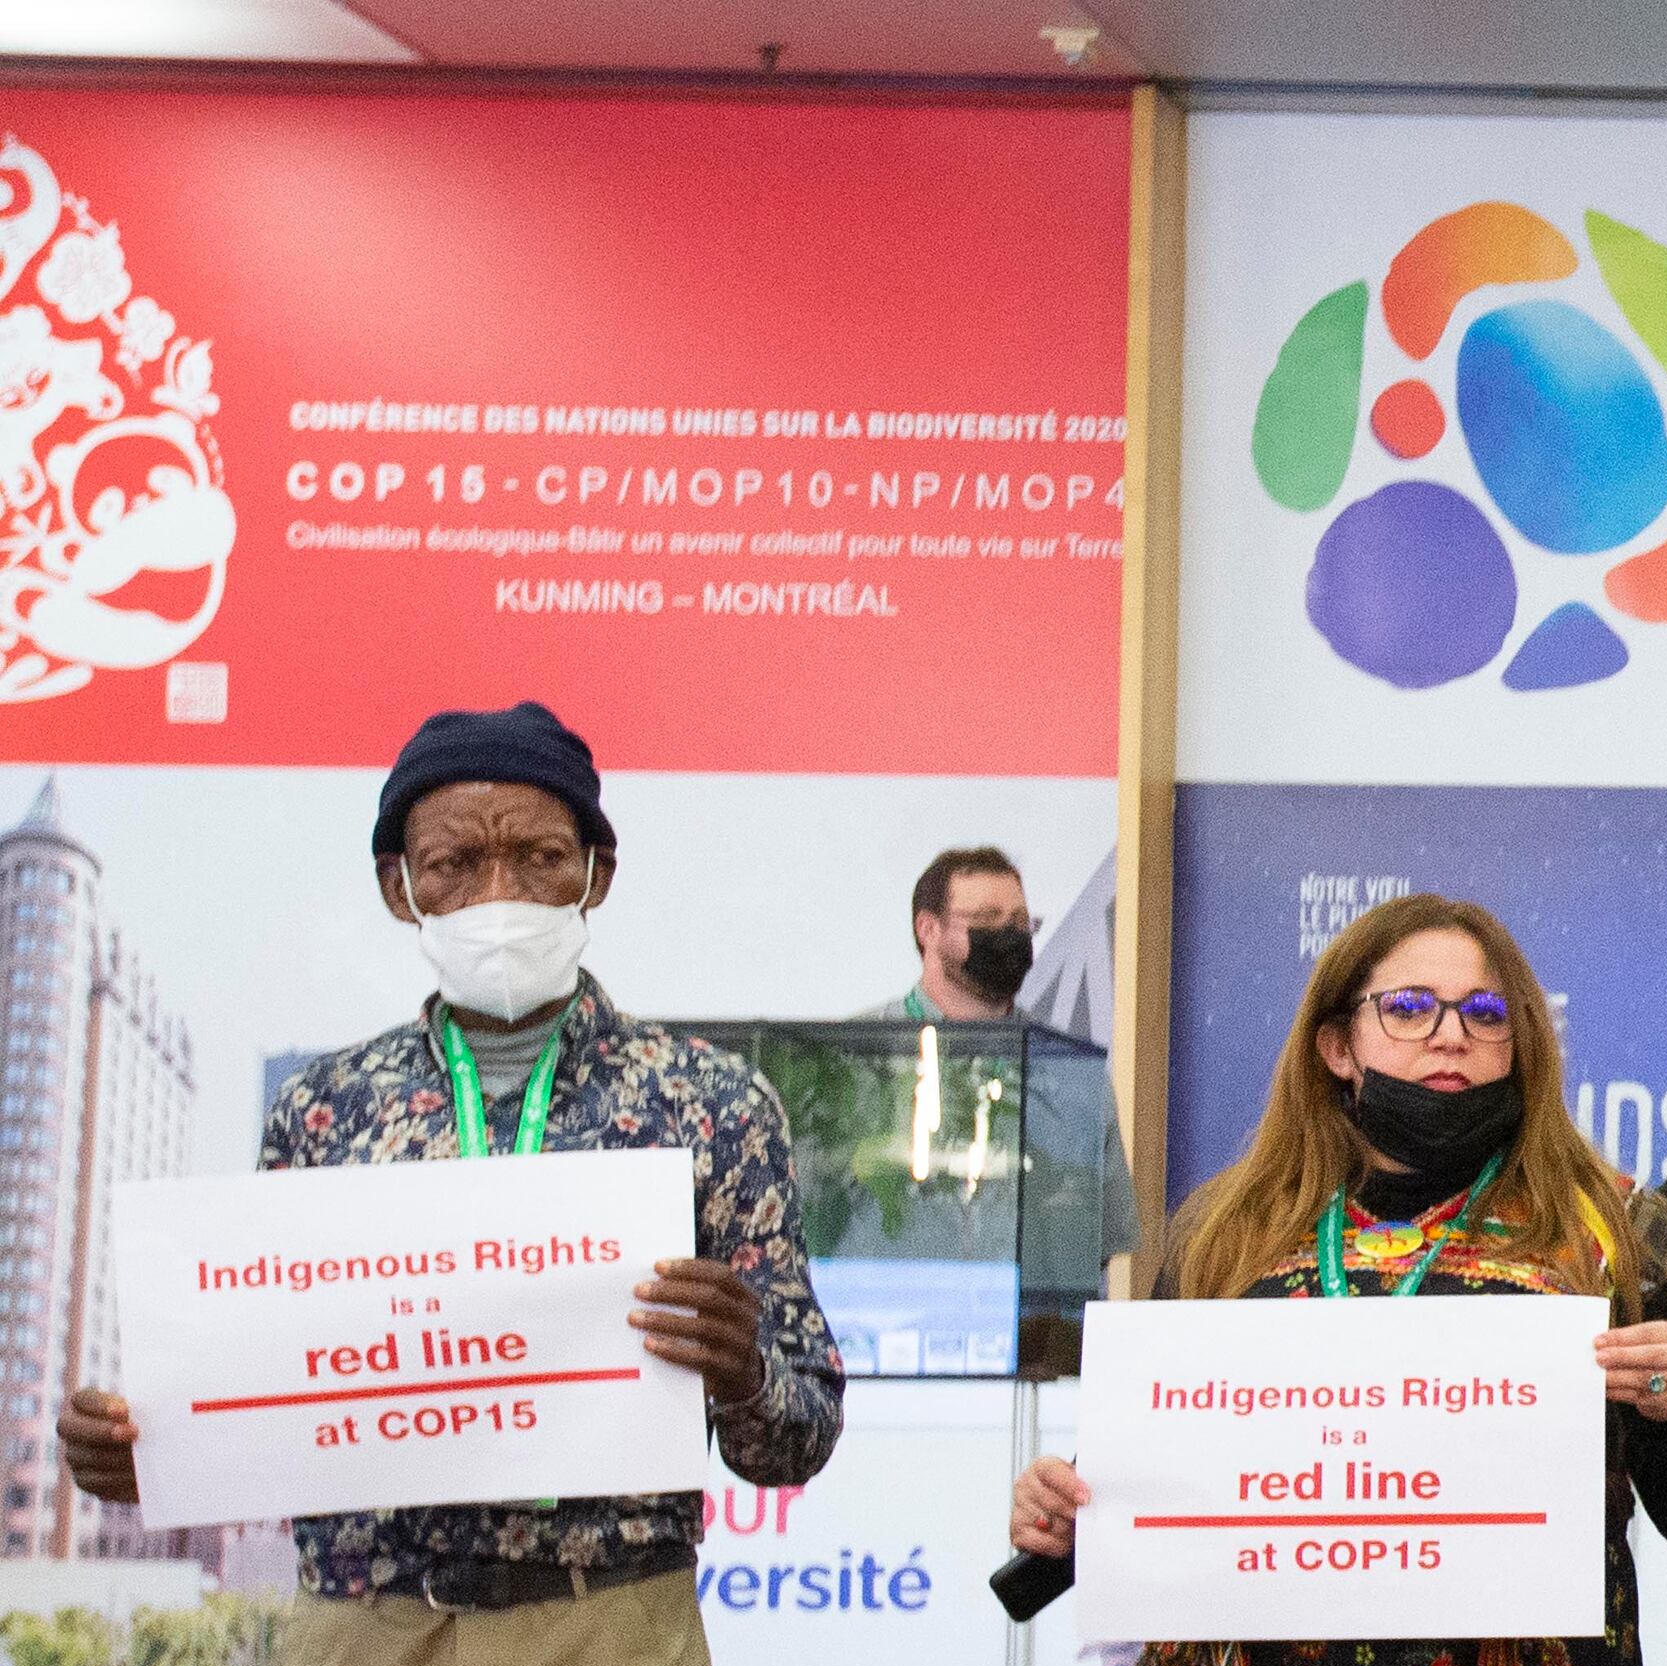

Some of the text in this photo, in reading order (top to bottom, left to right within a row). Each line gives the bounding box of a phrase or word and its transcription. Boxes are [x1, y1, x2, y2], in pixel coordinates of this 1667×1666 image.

[290, 396, 478, 433] CONFÉRENCE
[484, 407, 539, 435] DES
[545, 407, 666, 436] NATIONS
[672, 407, 757, 437] UNIES
[763, 409, 818, 438] SUR
[826, 412, 860, 439] LA
[867, 409, 1057, 442] BIODIVERSITÉ
[287, 461, 405, 502] COP
[631, 529, 662, 553] un
[669, 527, 744, 555] avenir
[750, 531, 843, 557] collectif
[848, 538, 902, 560] pour
[910, 535, 971, 557] toute
[978, 538, 1013, 558] vie
[1020, 540, 1059, 559] sur
[496, 577, 663, 614] KUNMING
[704, 579, 898, 616] MONTRÉAL
[198, 1235, 622, 1292] Indigenous Rights
[390, 1296, 442, 1315] is a
[304, 1327, 528, 1379] red line
[1151, 1376, 1538, 1417] Indigenous Rights
[314, 1396, 538, 1449] at COP15
[1321, 1426, 1368, 1445] is a
[1238, 1459, 1441, 1503] red line
[1236, 1538, 1442, 1573] at COP15
